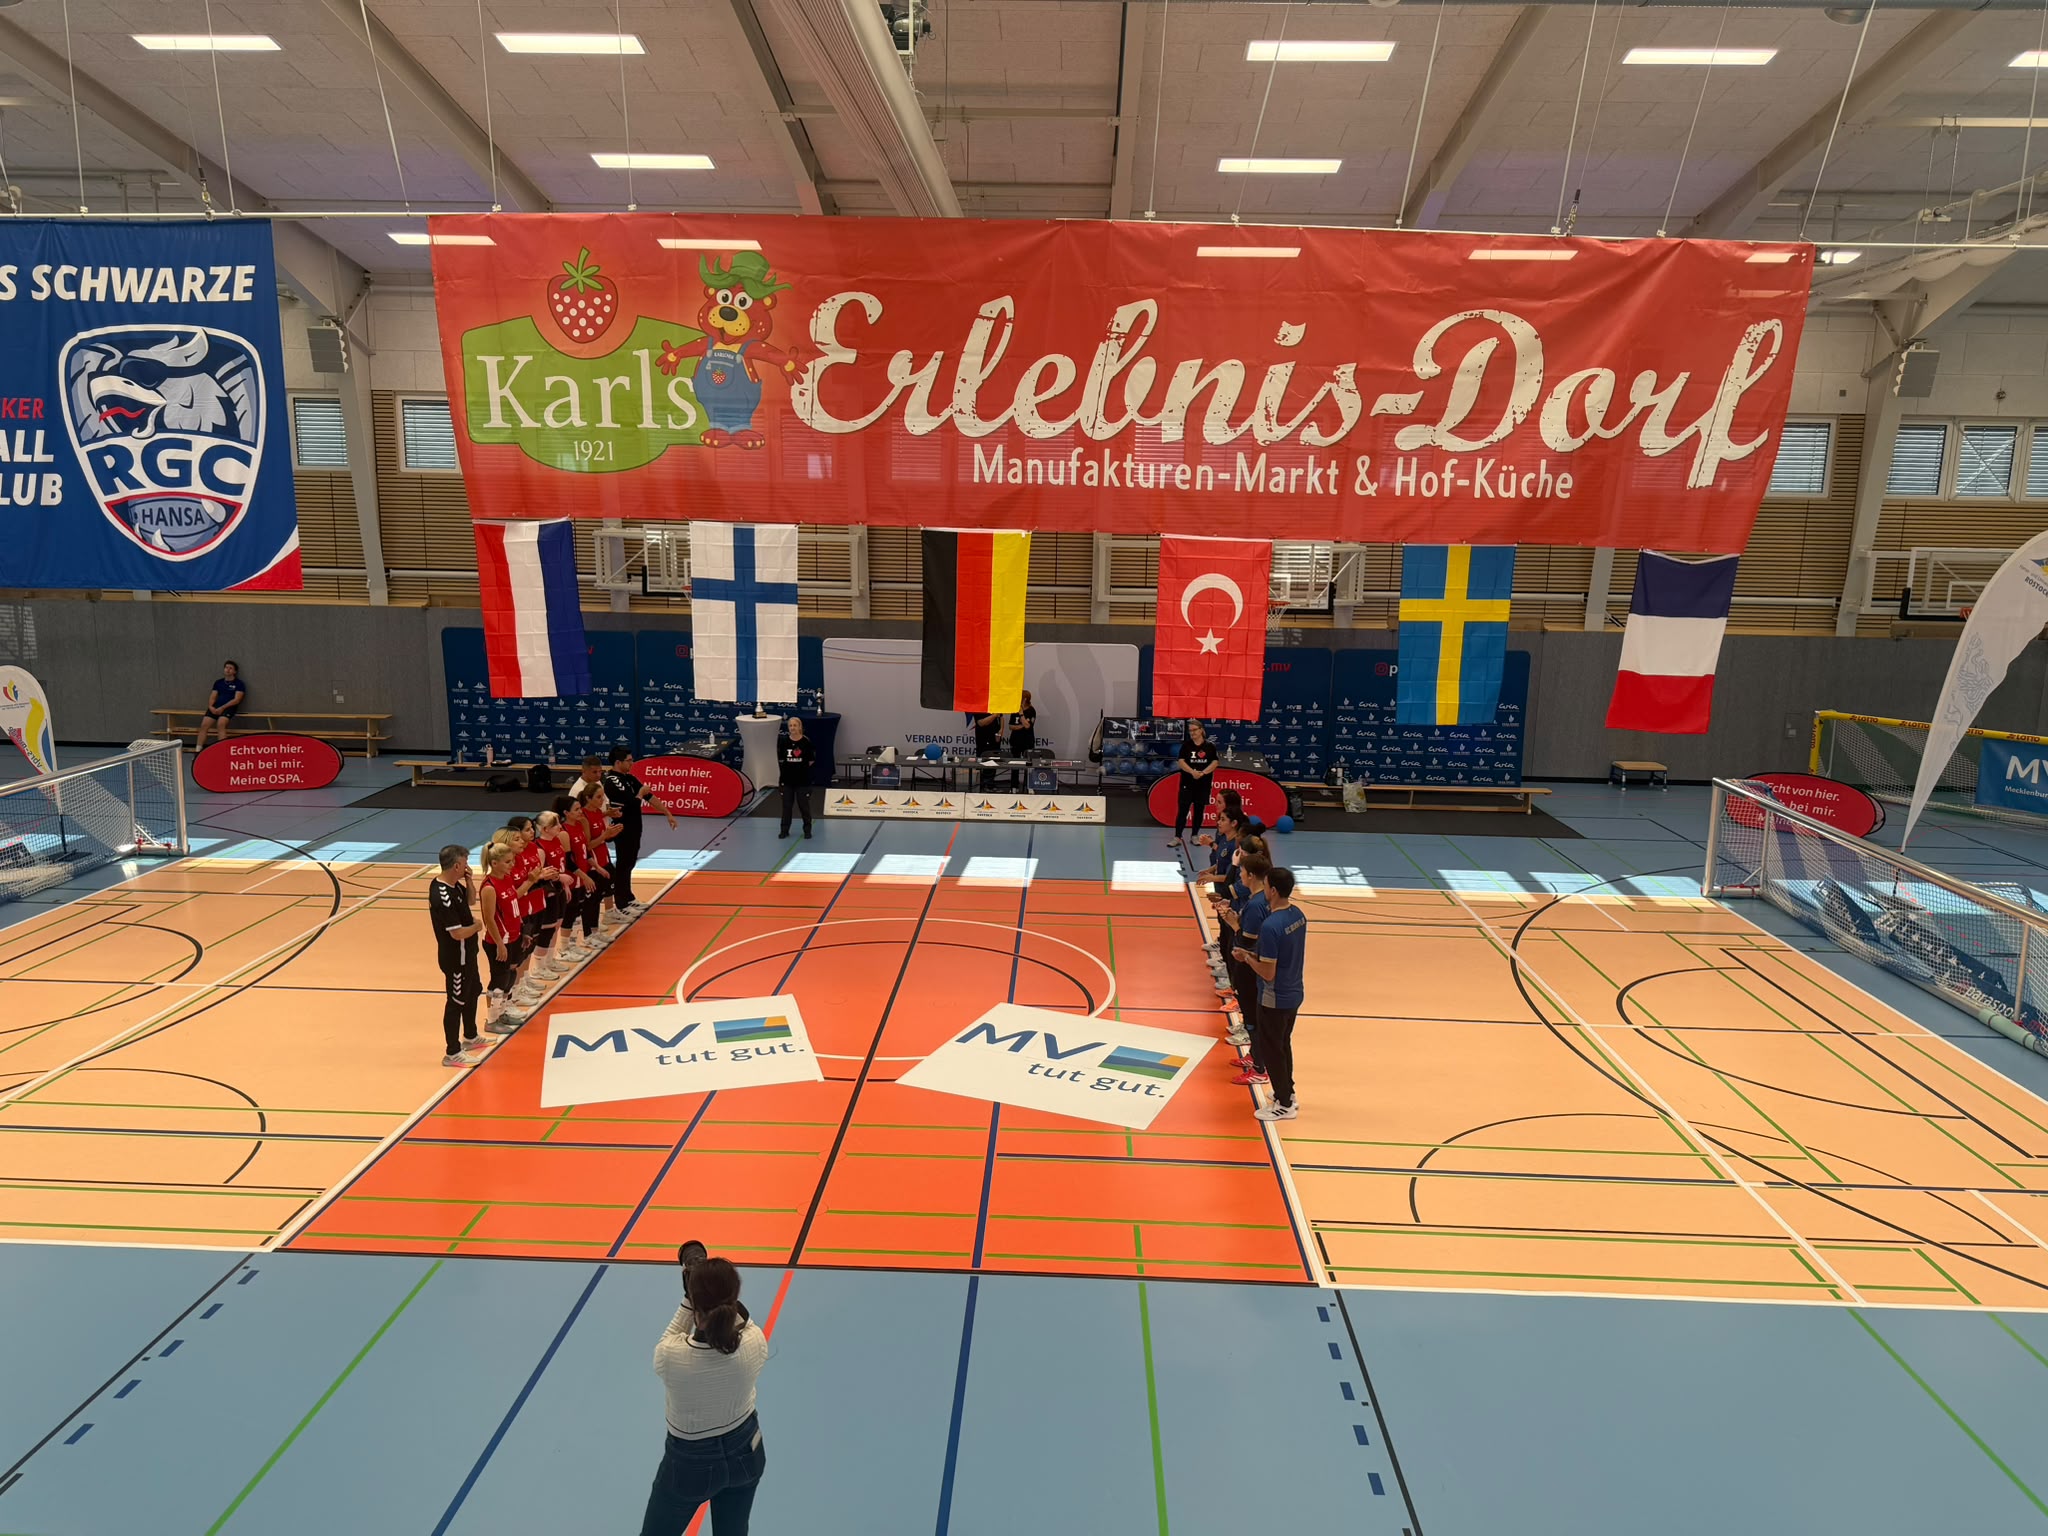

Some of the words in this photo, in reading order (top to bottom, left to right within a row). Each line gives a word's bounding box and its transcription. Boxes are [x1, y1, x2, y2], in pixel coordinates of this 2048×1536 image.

[31, 264, 256, 303] SCHWARZE
[477, 348, 698, 430] Karls
[790, 291, 1783, 489] Erlebnis-Dorf
[573, 440, 614, 462] 1921
[85, 437, 254, 496] RGC
[973, 443, 1339, 496] Manufakturen-Markt
[1353, 455, 1378, 496] &
[1394, 456, 1574, 499] Hof-Küche
[142, 504, 206, 528] HANSA
[905, 734, 953, 744] VERBAND
[956, 734, 976, 745] FÜR
[2016, 734, 2040, 742] LOTTO
[230, 745, 256, 756] Echt
[280, 744, 304, 754] hier.
[230, 761, 254, 770] Nah
[258, 759, 277, 769] bei
[281, 759, 304, 769] mir.
[645, 766, 668, 776] Echt
[690, 767, 712, 778] hier.
[2006, 756, 2048, 784] M
[230, 775, 266, 785] Meine
[269, 774, 304, 784] OSPA.
[668, 782, 685, 792] bei
[689, 784, 710, 794] mir.
[1229, 780, 1252, 790] hier.
[676, 798, 708, 810] OSPA.
[1792, 787, 1813, 797] von
[1815, 788, 1840, 801] hier.
[1790, 800, 1809, 812] bei
[1812, 805, 1836, 817] mir.
[511, 898, 520, 918] 10
[552, 1022, 702, 1058] MV
[955, 1022, 1108, 1060] MV
[655, 1049, 717, 1066] tut
[730, 1042, 805, 1062] gut.
[1027, 1062, 1085, 1082] tut
[1090, 1077, 1165, 1098] gut.
